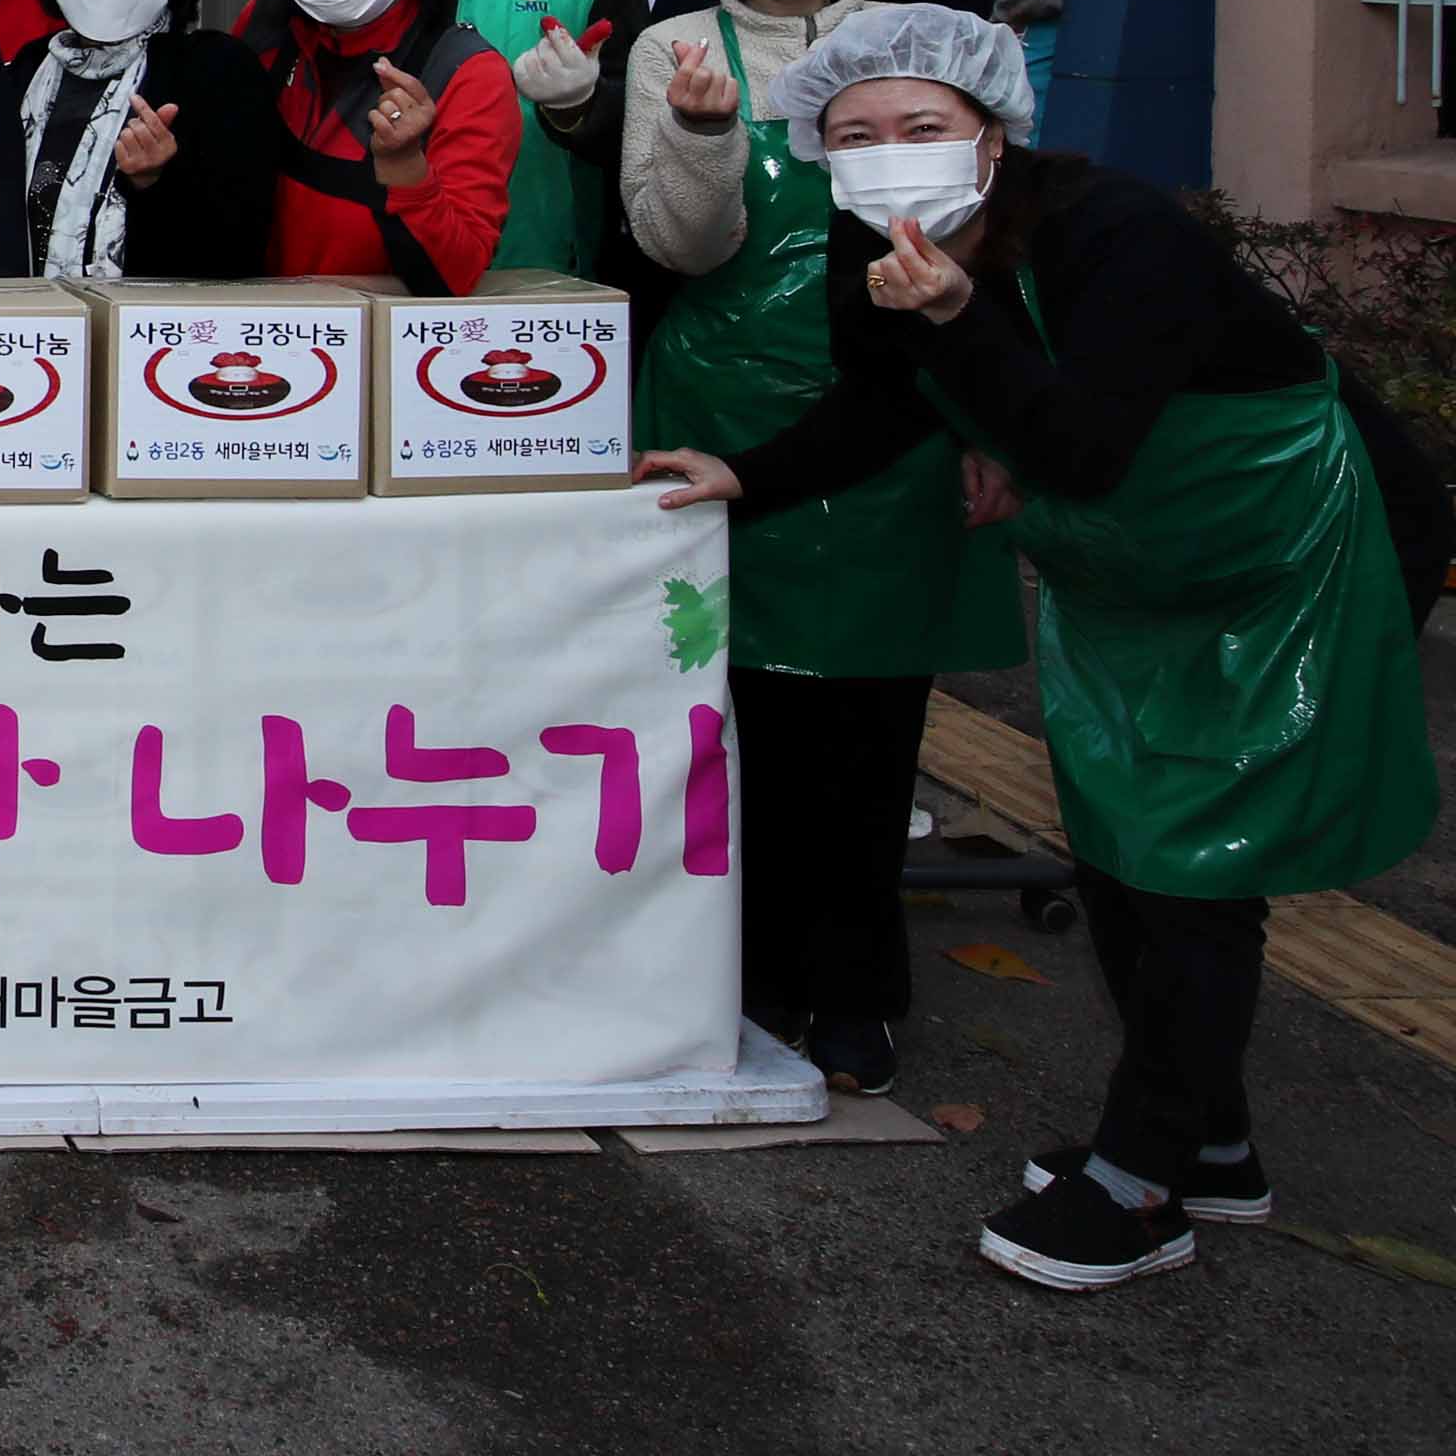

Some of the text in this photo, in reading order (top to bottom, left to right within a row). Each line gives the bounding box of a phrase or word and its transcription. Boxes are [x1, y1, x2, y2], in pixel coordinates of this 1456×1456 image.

[514, 0, 548, 14] SMU
[240, 323, 349, 347] 김장나눔
[510, 318, 620, 346] 김장나눔
[147, 441, 205, 461] 송림2동
[214, 441, 309, 461] 새마을부녀회
[421, 439, 478, 459] 송림2동
[487, 436, 580, 457] 새마을부녀회
[131, 703, 730, 907] 나누기
